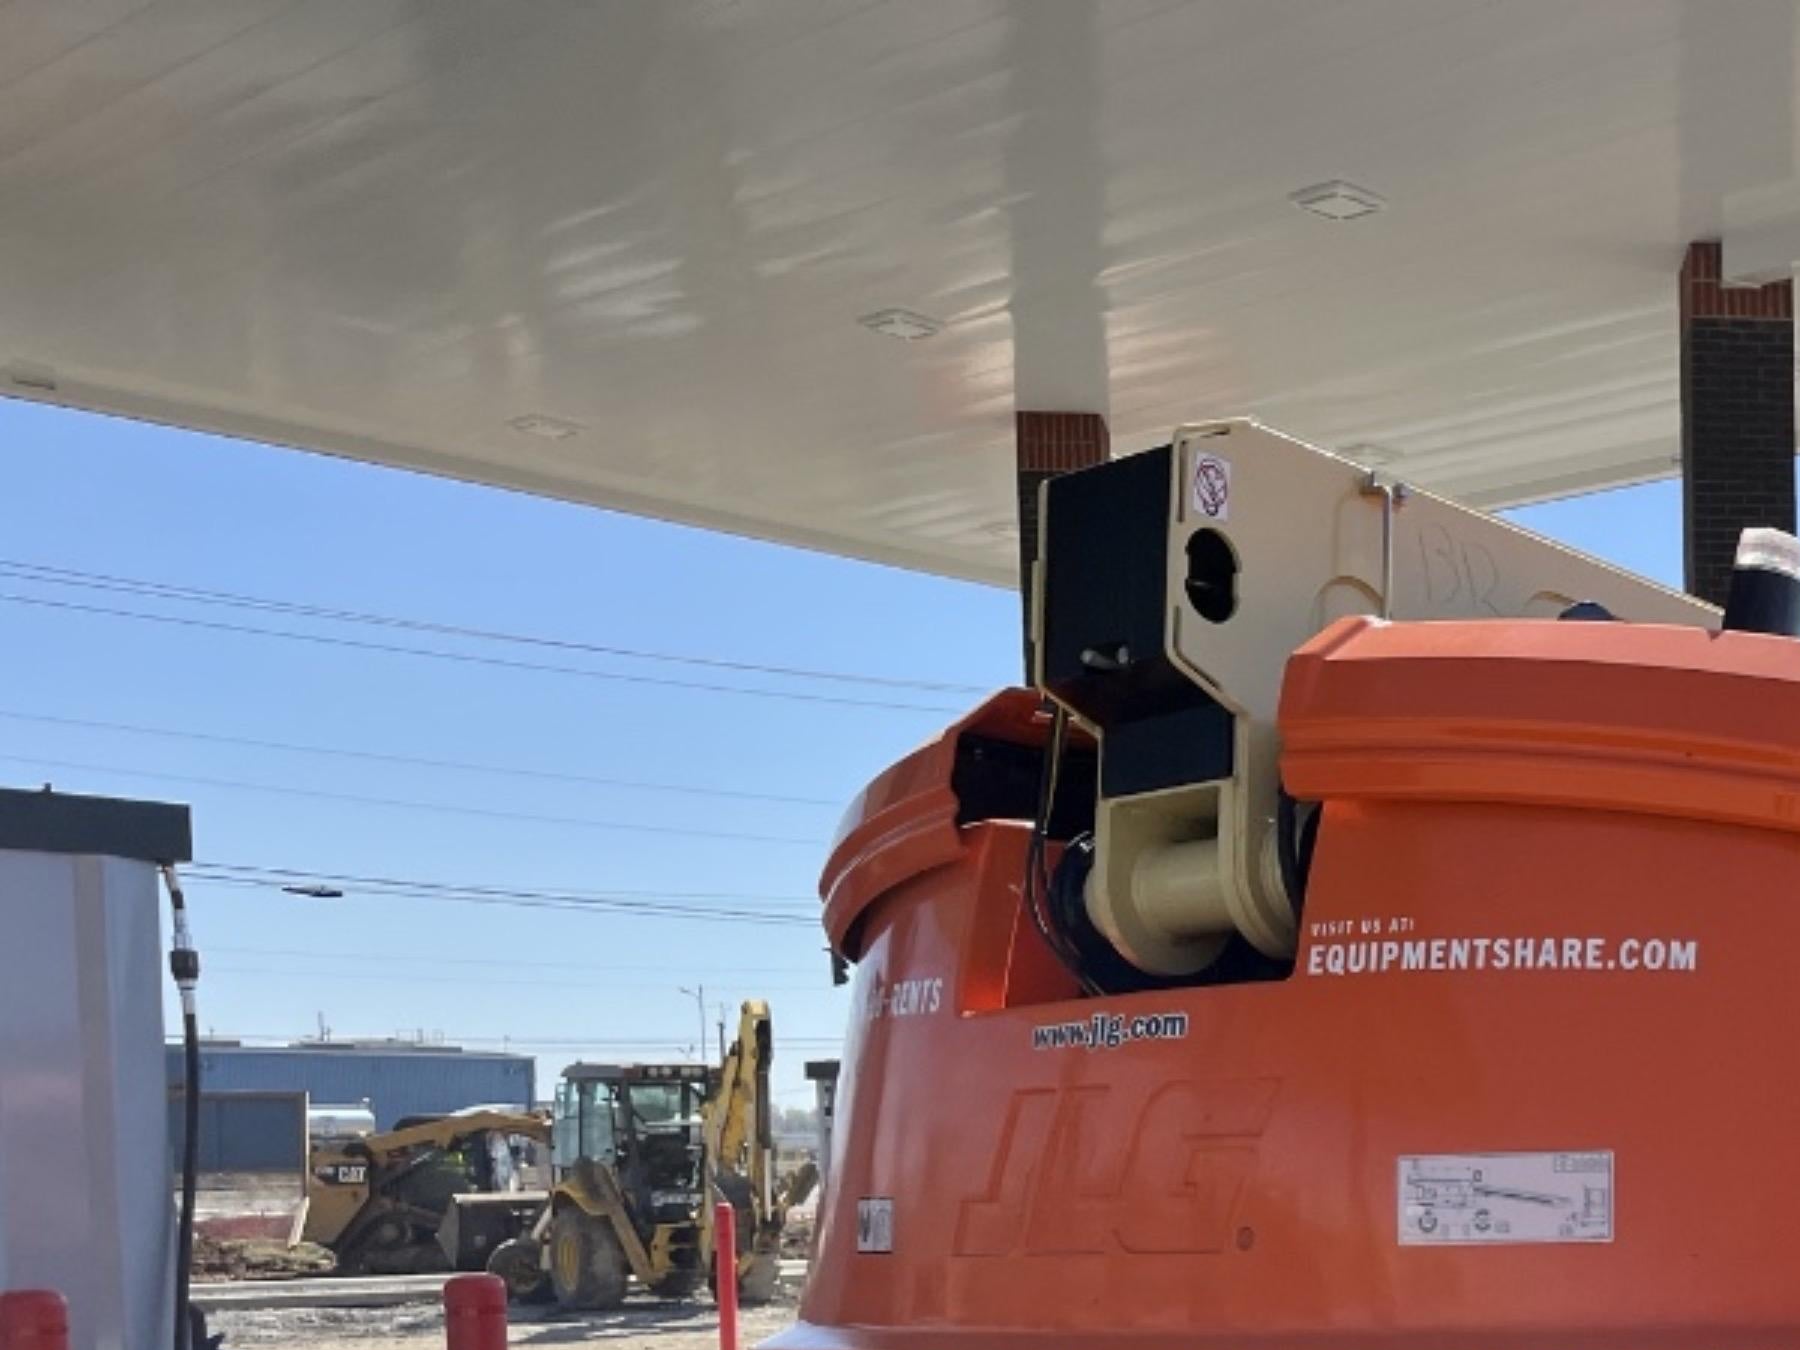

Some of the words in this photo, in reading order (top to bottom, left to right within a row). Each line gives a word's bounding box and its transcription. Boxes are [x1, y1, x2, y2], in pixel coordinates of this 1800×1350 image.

[1310, 920, 1354, 937] VISIT
[1361, 919, 1382, 935] US
[1306, 938, 1698, 977] EQUIPMENTSHARE.COM
[1032, 1010, 1189, 1050] www.jlg.com
[337, 1165, 367, 1184] CAT
[951, 1076, 1283, 1258] JLG
